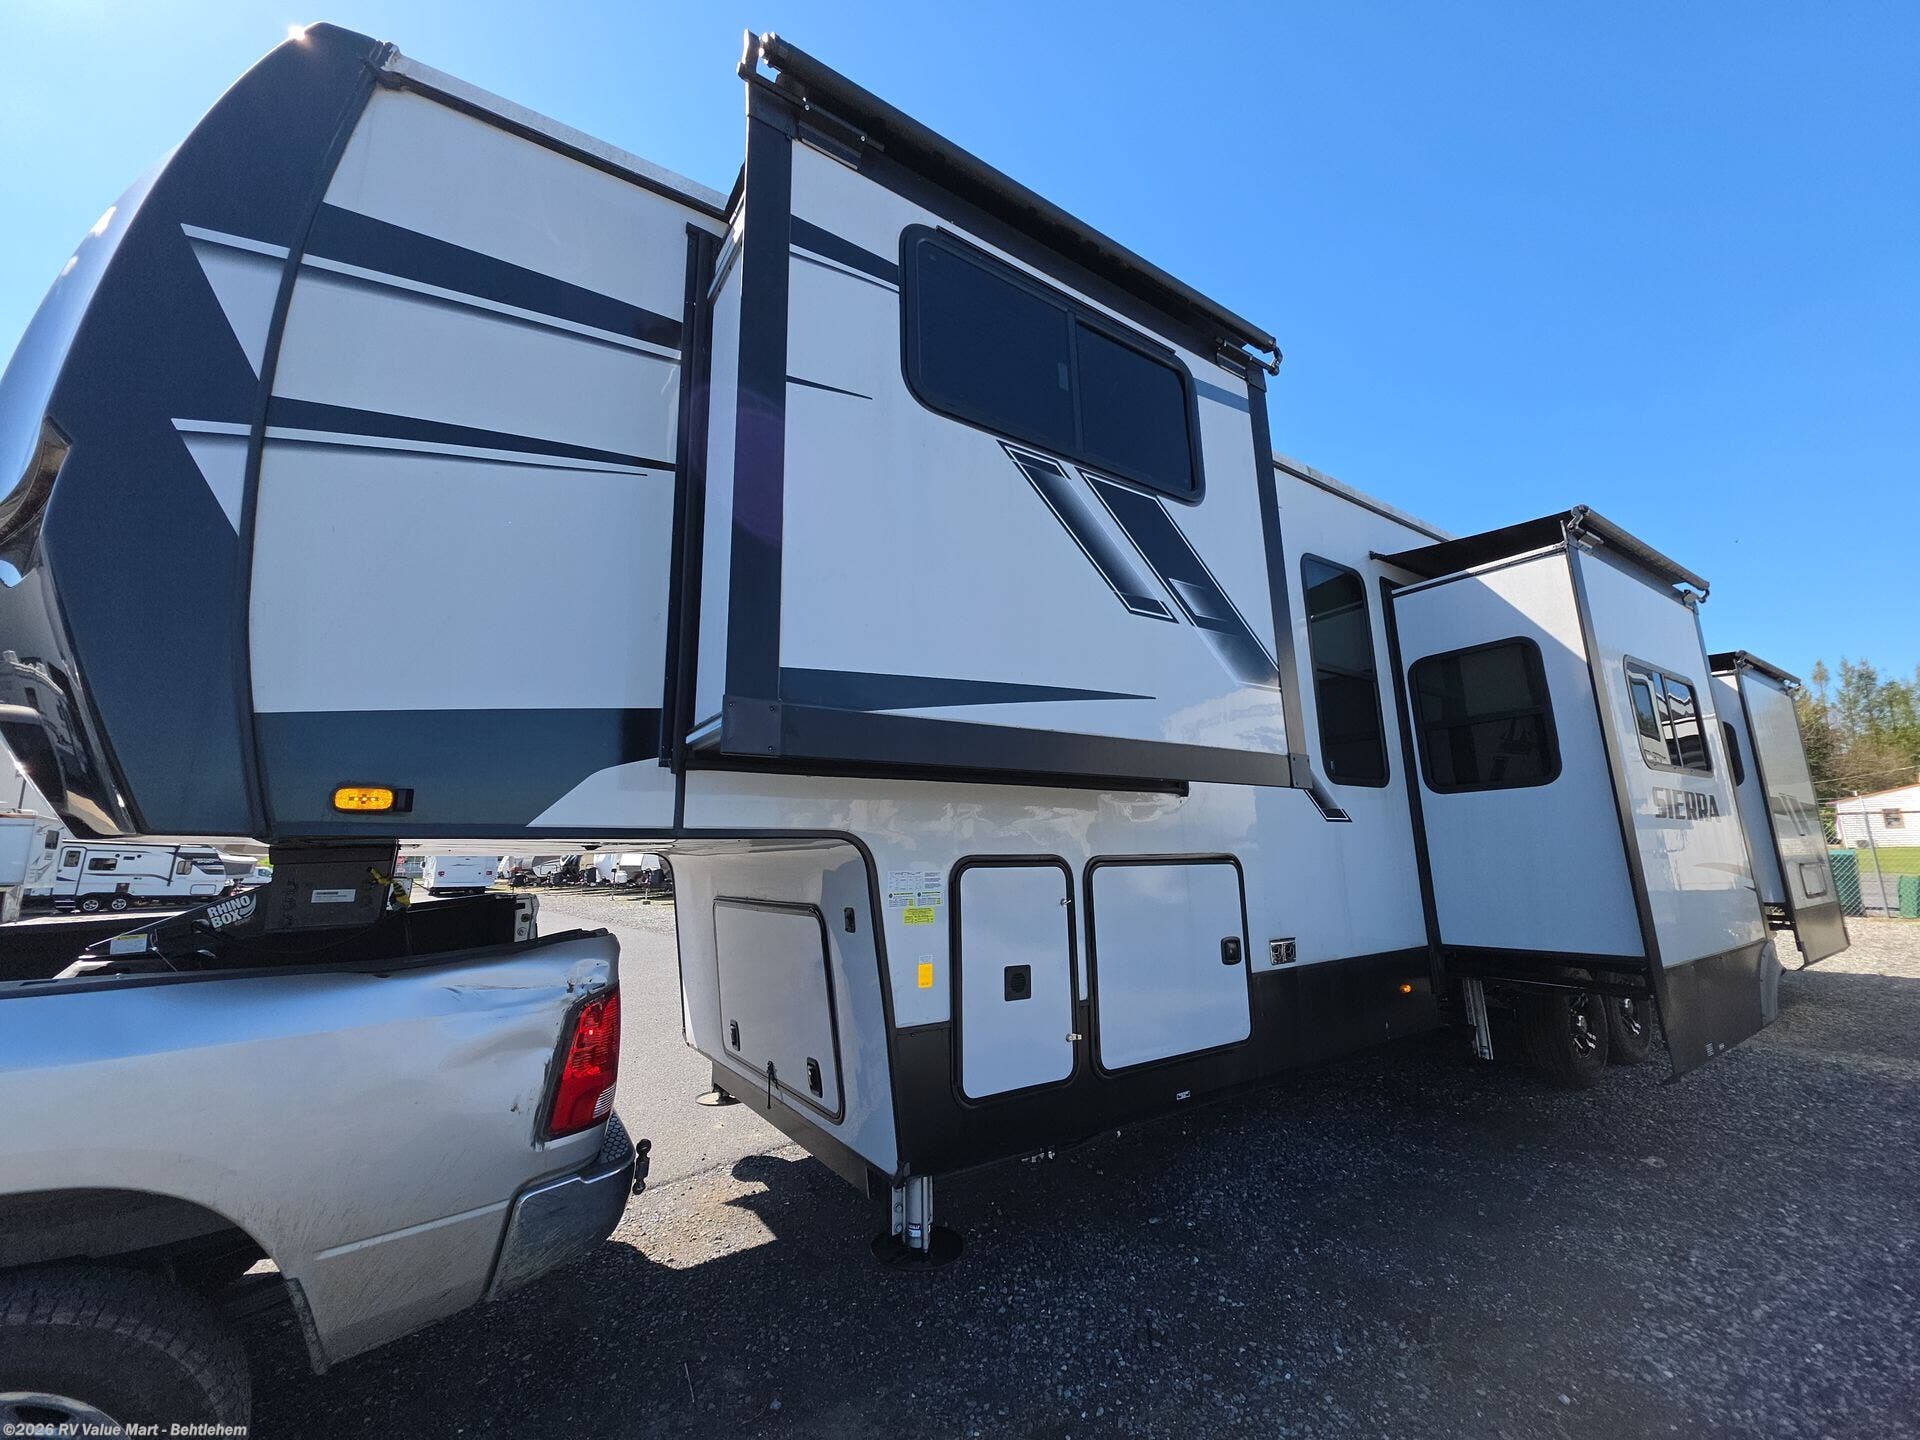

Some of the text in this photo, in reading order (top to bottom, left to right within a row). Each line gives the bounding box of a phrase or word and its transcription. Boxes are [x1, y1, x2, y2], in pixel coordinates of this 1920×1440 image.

[1652, 786, 1720, 820] SIERRA
[207, 895, 251, 918] RHINO
[211, 909, 242, 929] BOX
